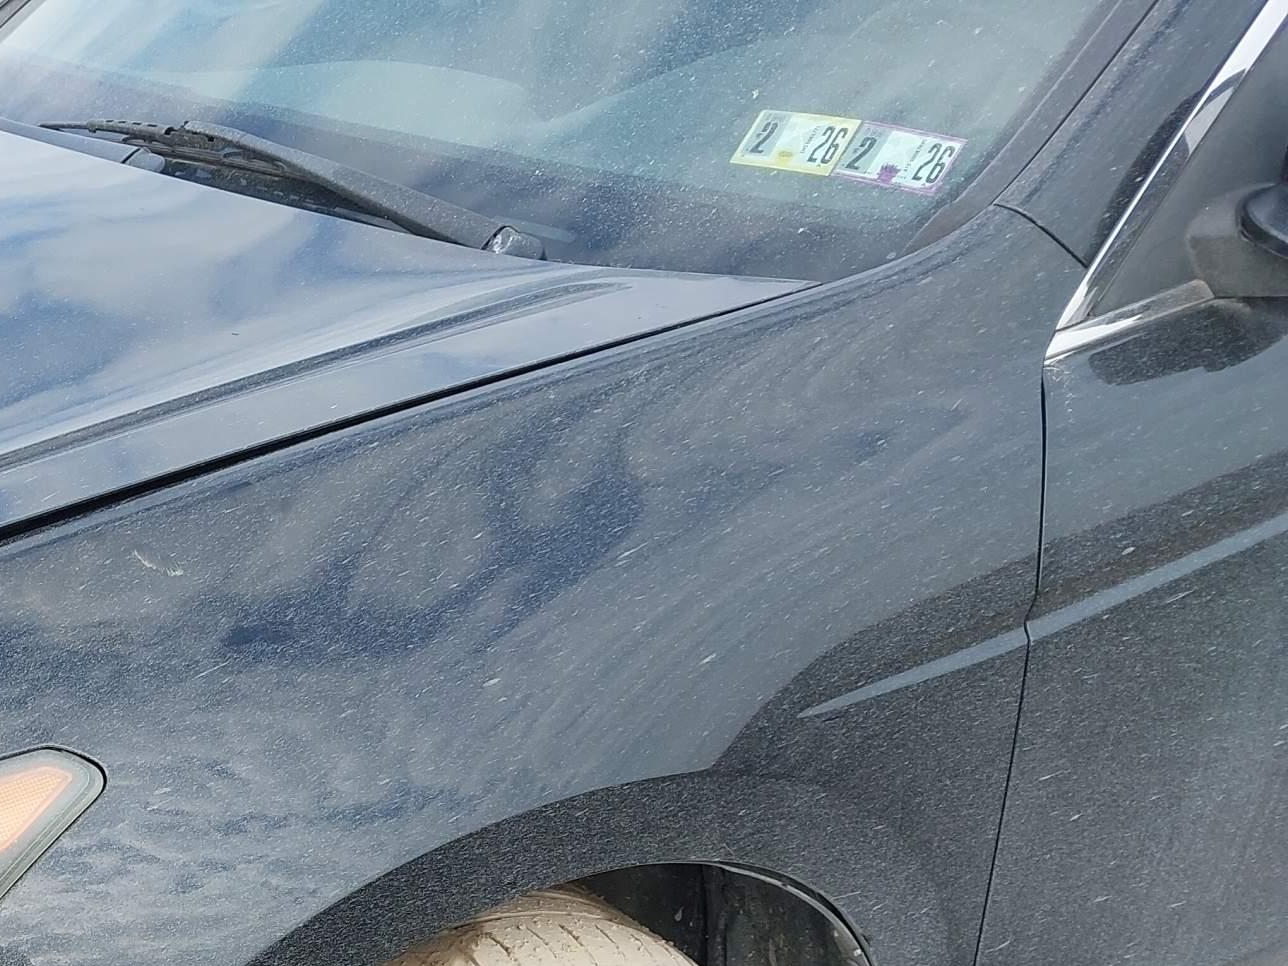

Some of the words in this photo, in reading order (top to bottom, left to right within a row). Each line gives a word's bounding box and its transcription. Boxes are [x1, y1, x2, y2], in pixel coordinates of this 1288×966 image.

[749, 120, 779, 154] 2
[806, 125, 849, 165] 26
[844, 136, 877, 170] 2
[911, 142, 956, 184] 26
